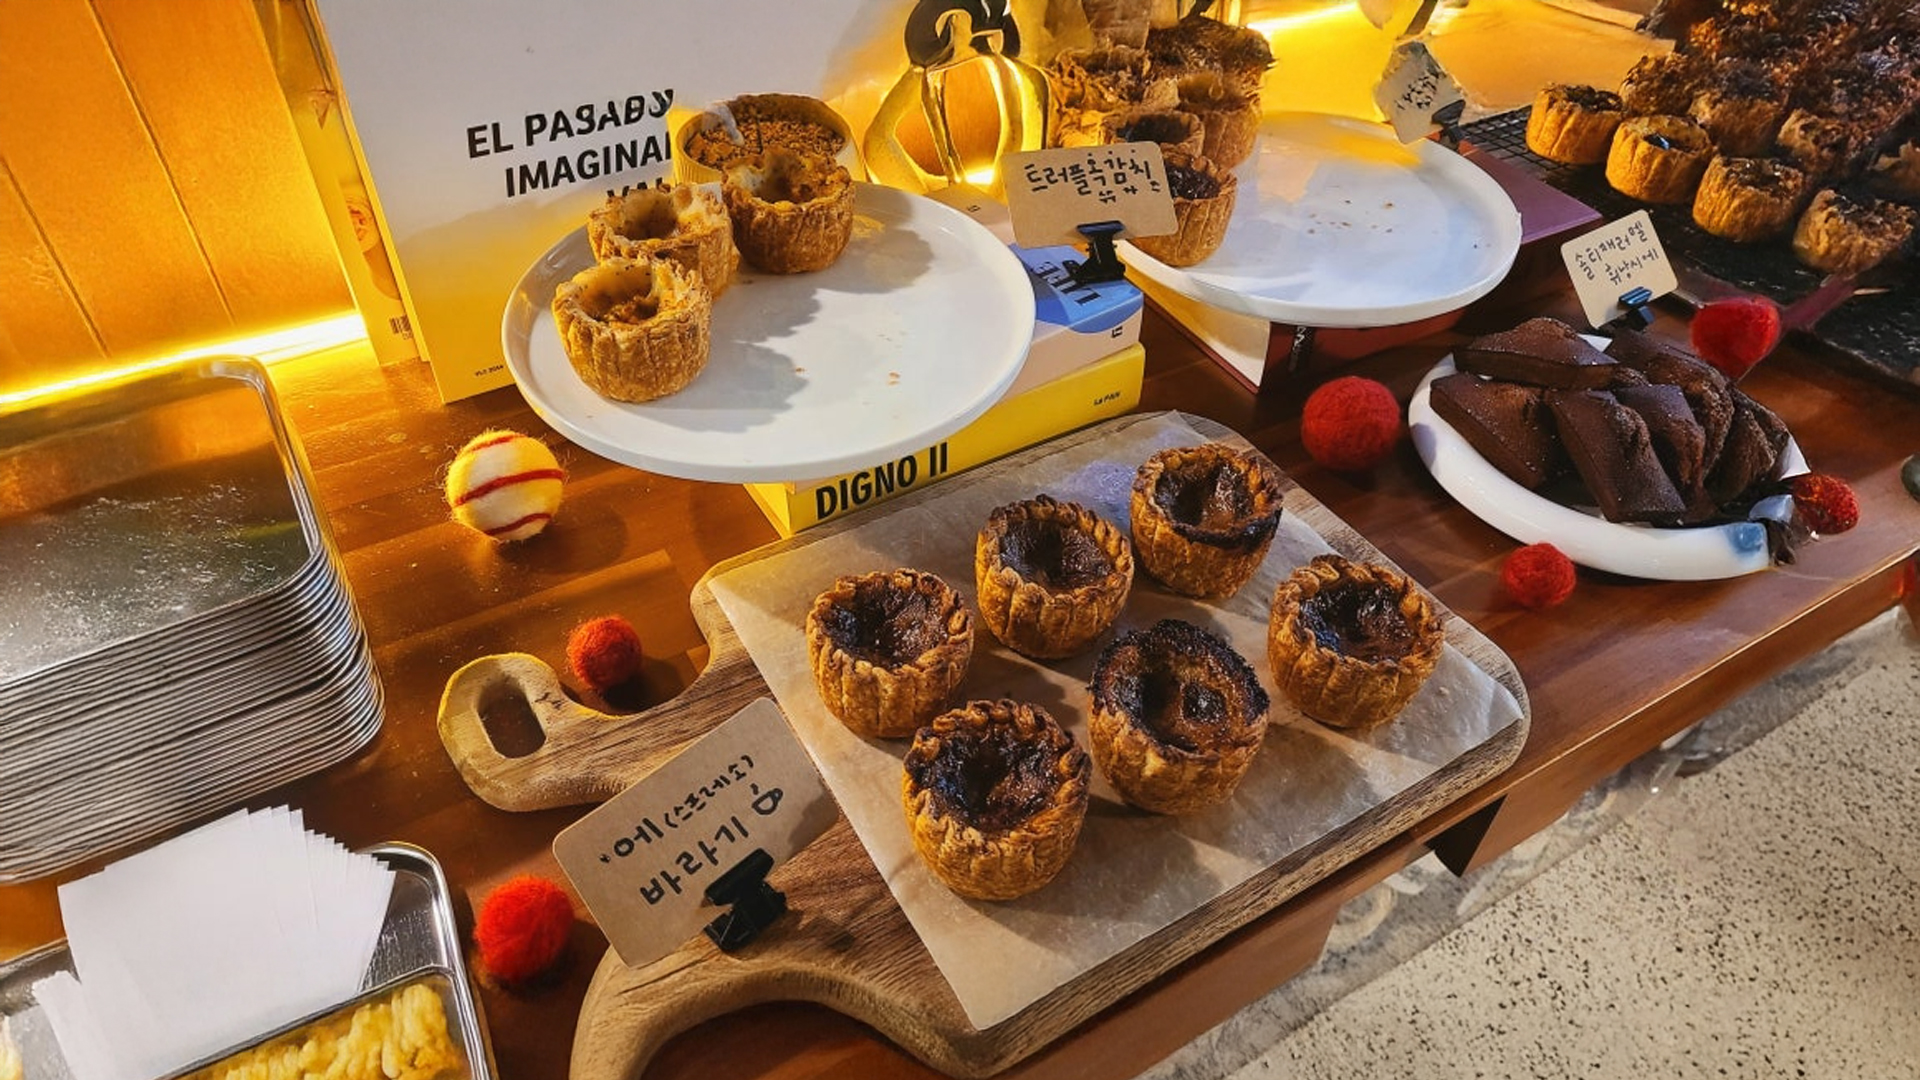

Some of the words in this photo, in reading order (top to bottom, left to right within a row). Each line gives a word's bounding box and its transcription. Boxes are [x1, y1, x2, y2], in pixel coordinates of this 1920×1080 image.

[467, 122, 514, 159] EL
[505, 131, 672, 198] IMAGINA
[816, 455, 918, 520] DIGNO
[640, 816, 749, 905] 바라기
